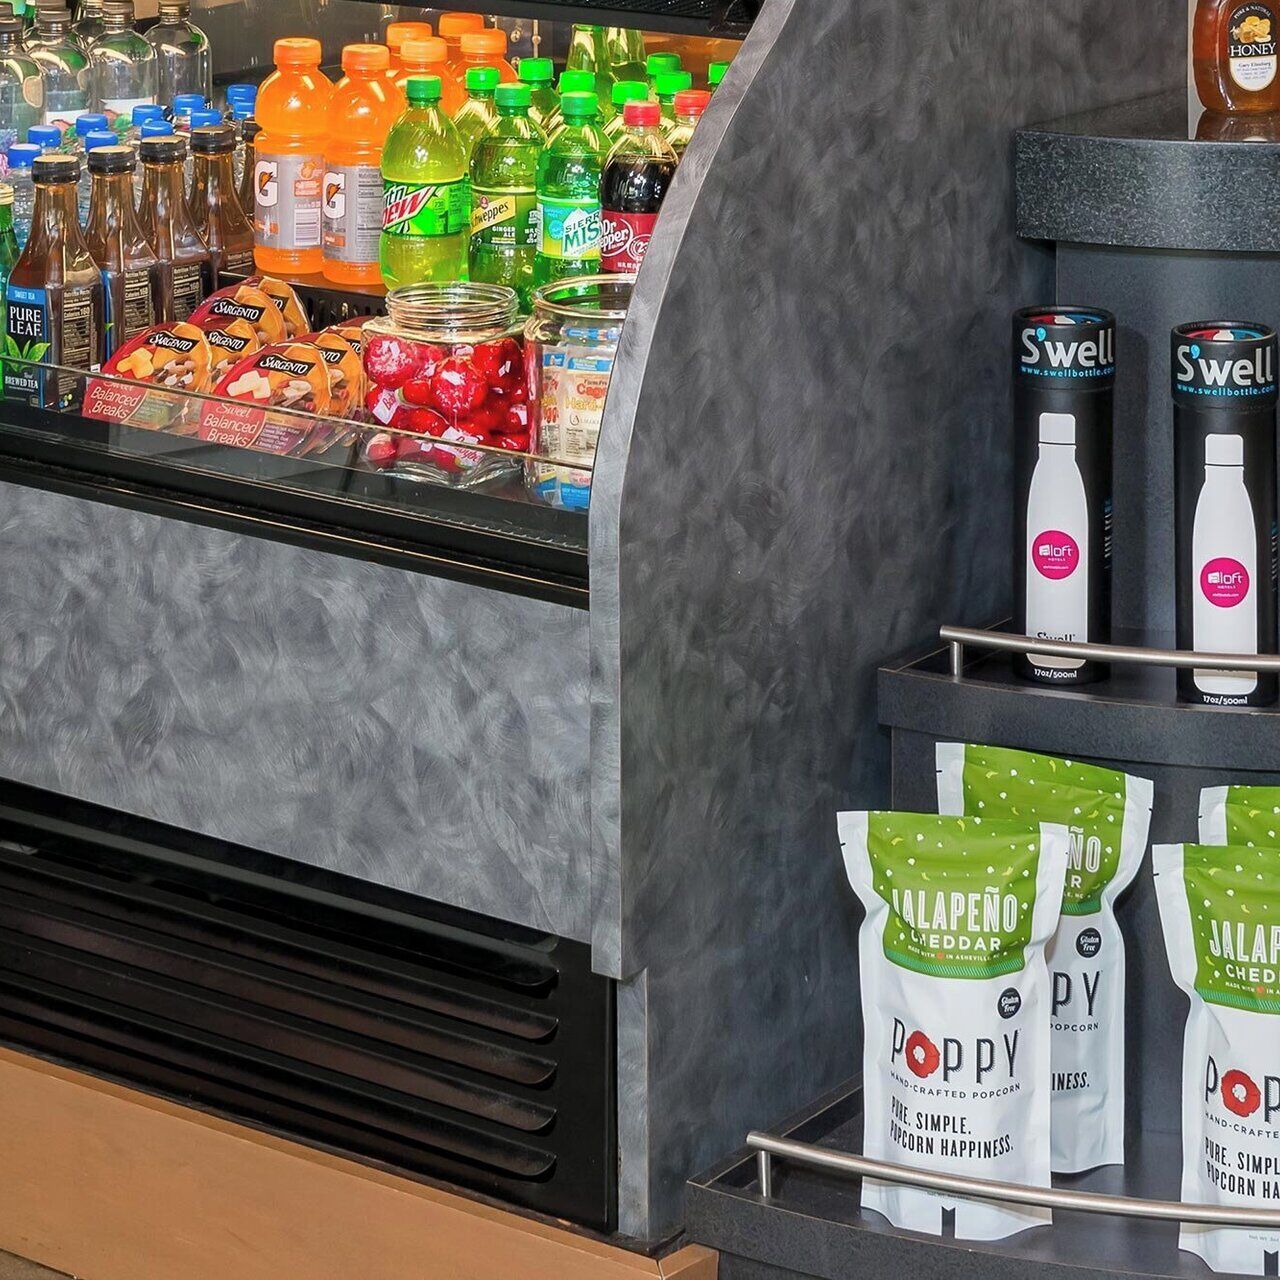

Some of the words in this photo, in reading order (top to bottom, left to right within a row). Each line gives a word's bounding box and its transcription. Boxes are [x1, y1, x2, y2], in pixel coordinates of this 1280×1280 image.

[1230, 43, 1276, 57] HONEY
[255, 160, 279, 207] G
[323, 171, 347, 219] G
[10, 306, 42, 323] PURE
[214, 300, 260, 320] SARGENTO
[149, 333, 193, 352] SARGENTO
[208, 331, 245, 349] SARGENTO
[1021, 327, 1114, 368] S'well
[260, 355, 309, 374] SARGENTO
[1177, 344, 1274, 386] S'well
[5, 376, 27, 388] BREWED
[27, 378, 38, 389] TEA
[90, 386, 138, 407] Balanced
[92, 401, 130, 419] Breaks
[215, 403, 250, 417] Sweet
[204, 415, 257, 434] Balanced
[207, 430, 250, 447] Breaks
[1039, 543, 1072, 557] aloft
[1208, 571, 1242, 585] aloft
[1034, 668, 1077, 680] 17oz/500ml
[1203, 695, 1248, 706] 17oz/500ml
[892, 886, 1018, 933] JALAPEÑO
[911, 930, 1001, 951] CHEDDAR
[1080, 934, 1099, 945] Gluten
[1225, 981, 1240, 990] MADE
[1241, 984, 1255, 993] WITH
[891, 1017, 1021, 1084] POPPY
[890, 1070, 967, 1099] HAND-CRAFTED
[972, 1082, 1021, 1100] POPCORN
[891, 1096, 911, 1127] PURE.
[916, 1111, 972, 1135] SIMPLE.
[890, 1120, 934, 1155] POPCORN
[941, 1133, 1014, 1159] HAPPINESS.
[1205, 1137, 1231, 1167] PURE.
[1206, 1161, 1256, 1197] POPCORN
